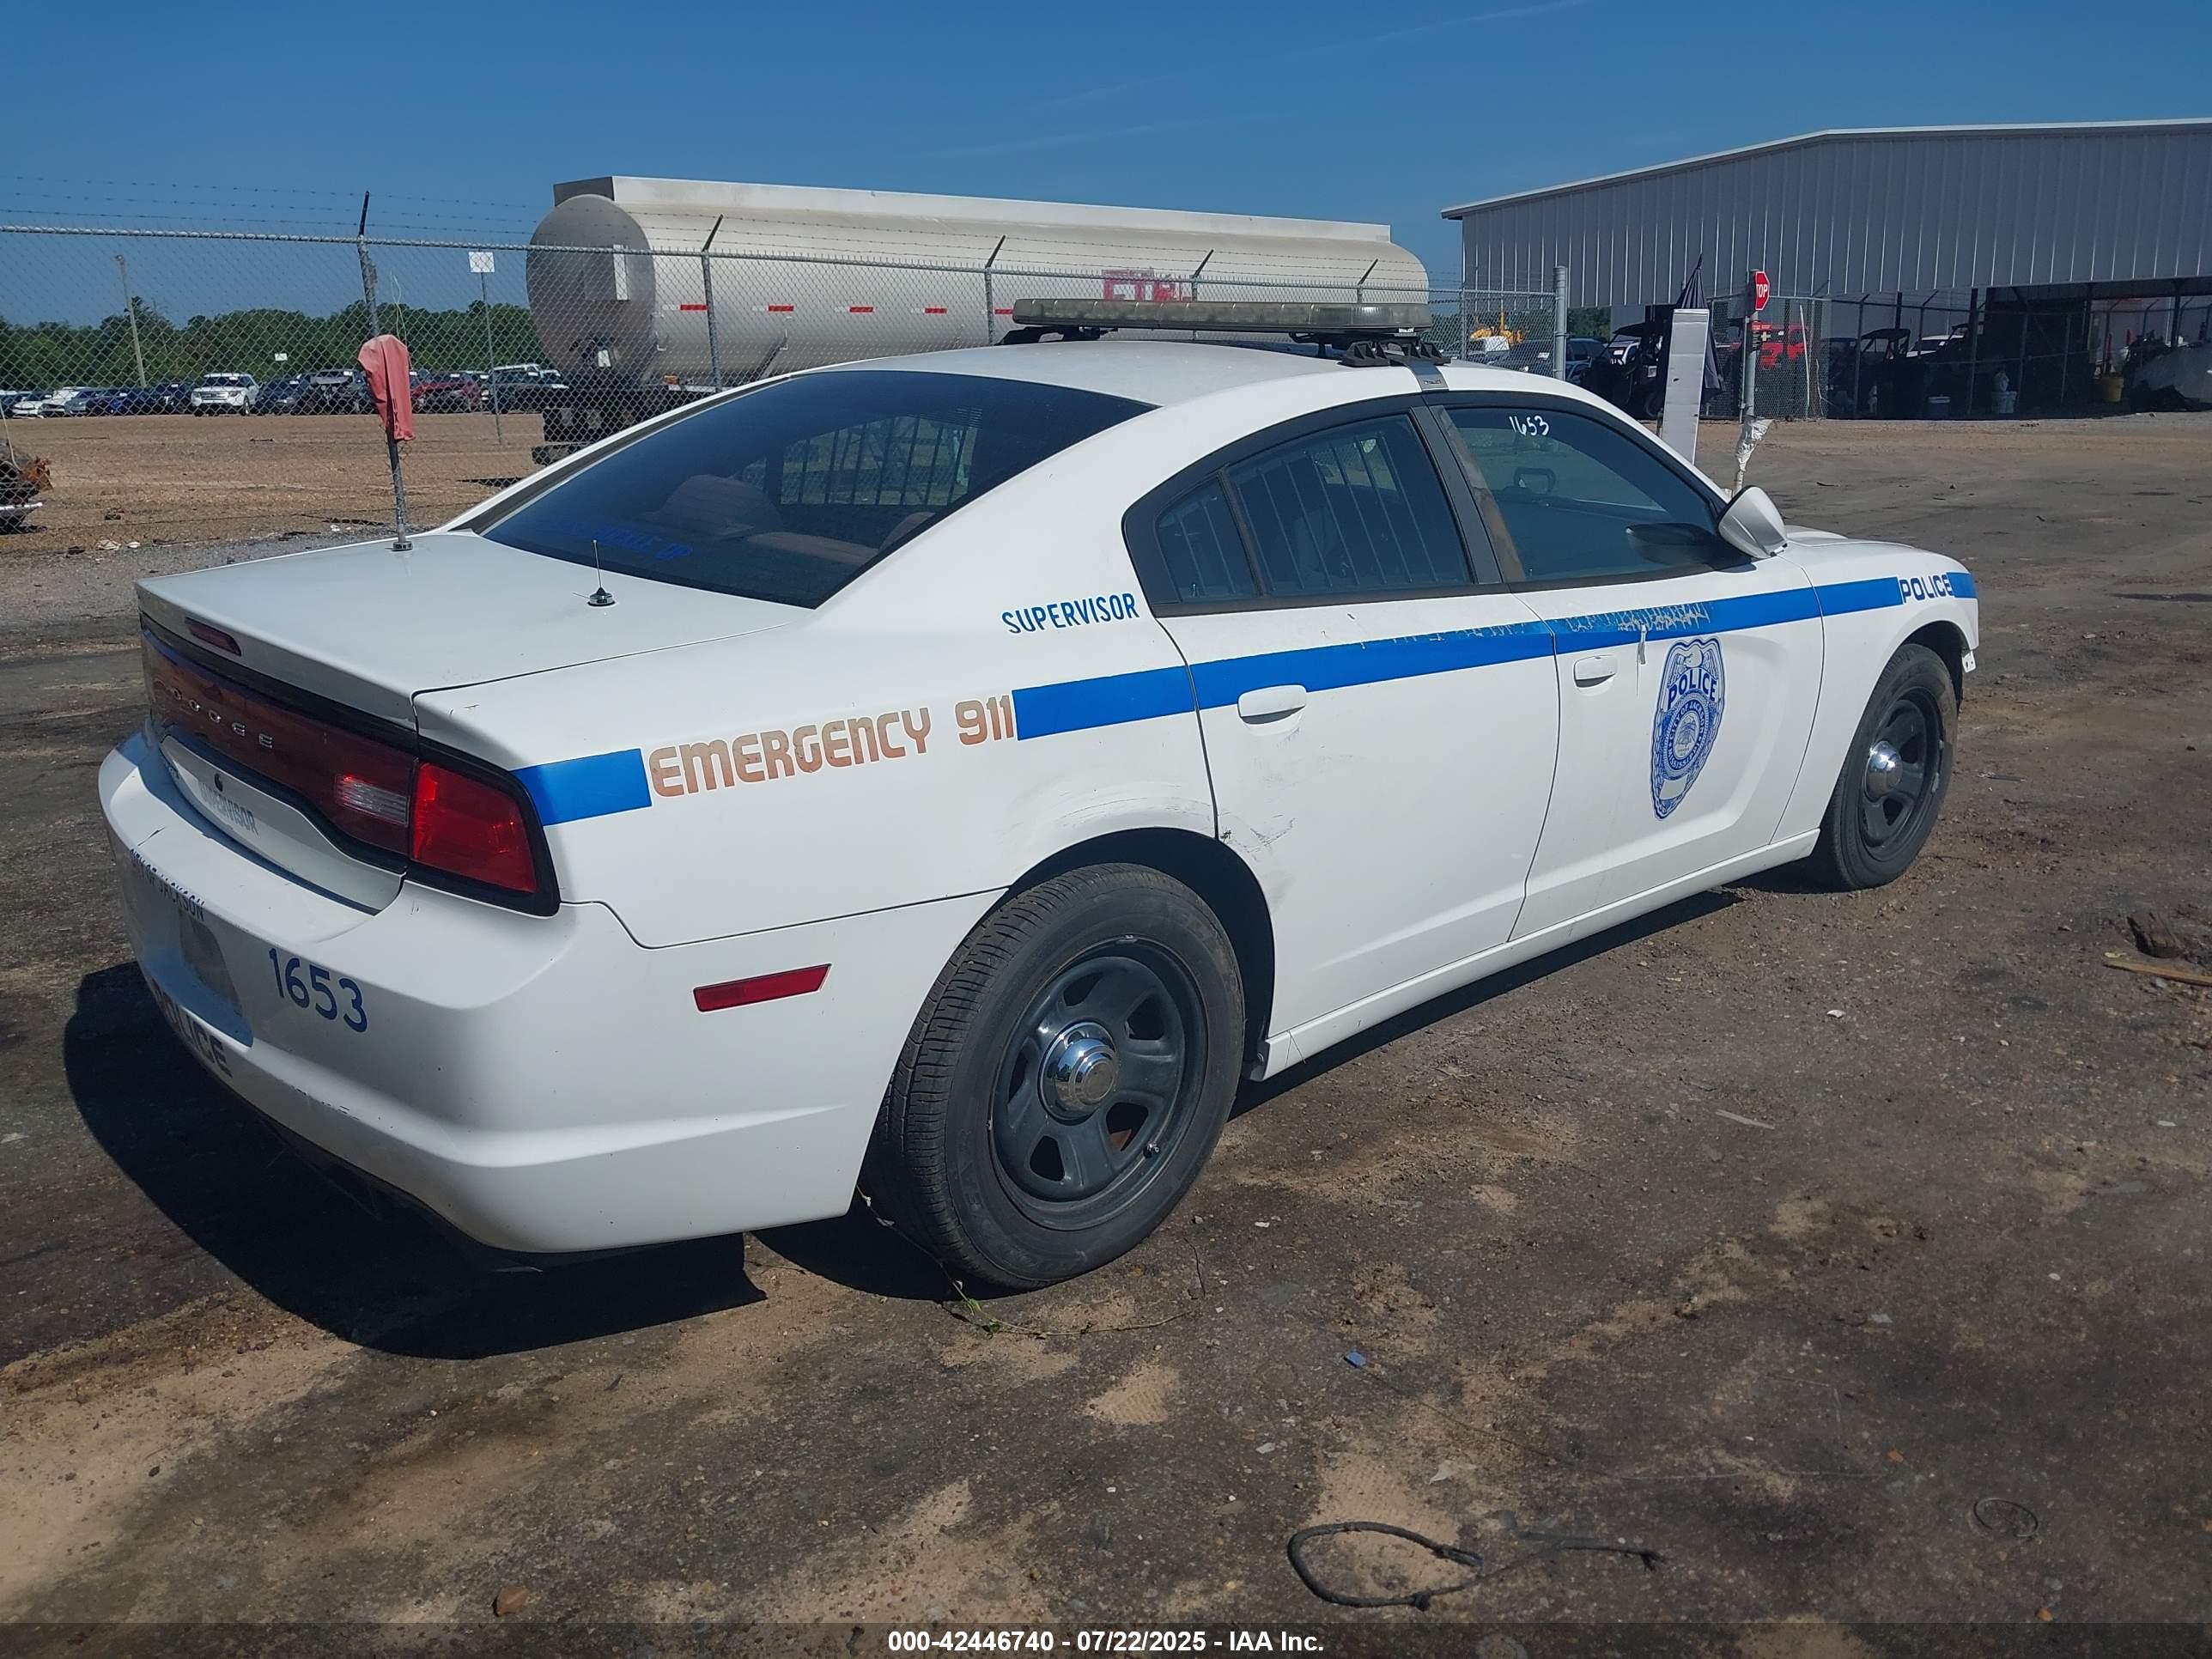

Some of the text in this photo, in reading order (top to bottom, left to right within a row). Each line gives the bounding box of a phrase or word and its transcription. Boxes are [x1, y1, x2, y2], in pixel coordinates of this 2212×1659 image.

[1755, 283, 1768, 298] TOP
[1509, 415, 1550, 436] 1653
[1899, 574, 1954, 603] POLICE
[1001, 592, 1140, 635] SUPERVISOR
[1668, 668, 1717, 711] POLICE
[172, 687, 274, 750] DODGE
[1689, 701, 1705, 733] JACKSON
[649, 694, 1016, 798] EMERGENCY 911
[269, 947, 368, 1033] 1653
